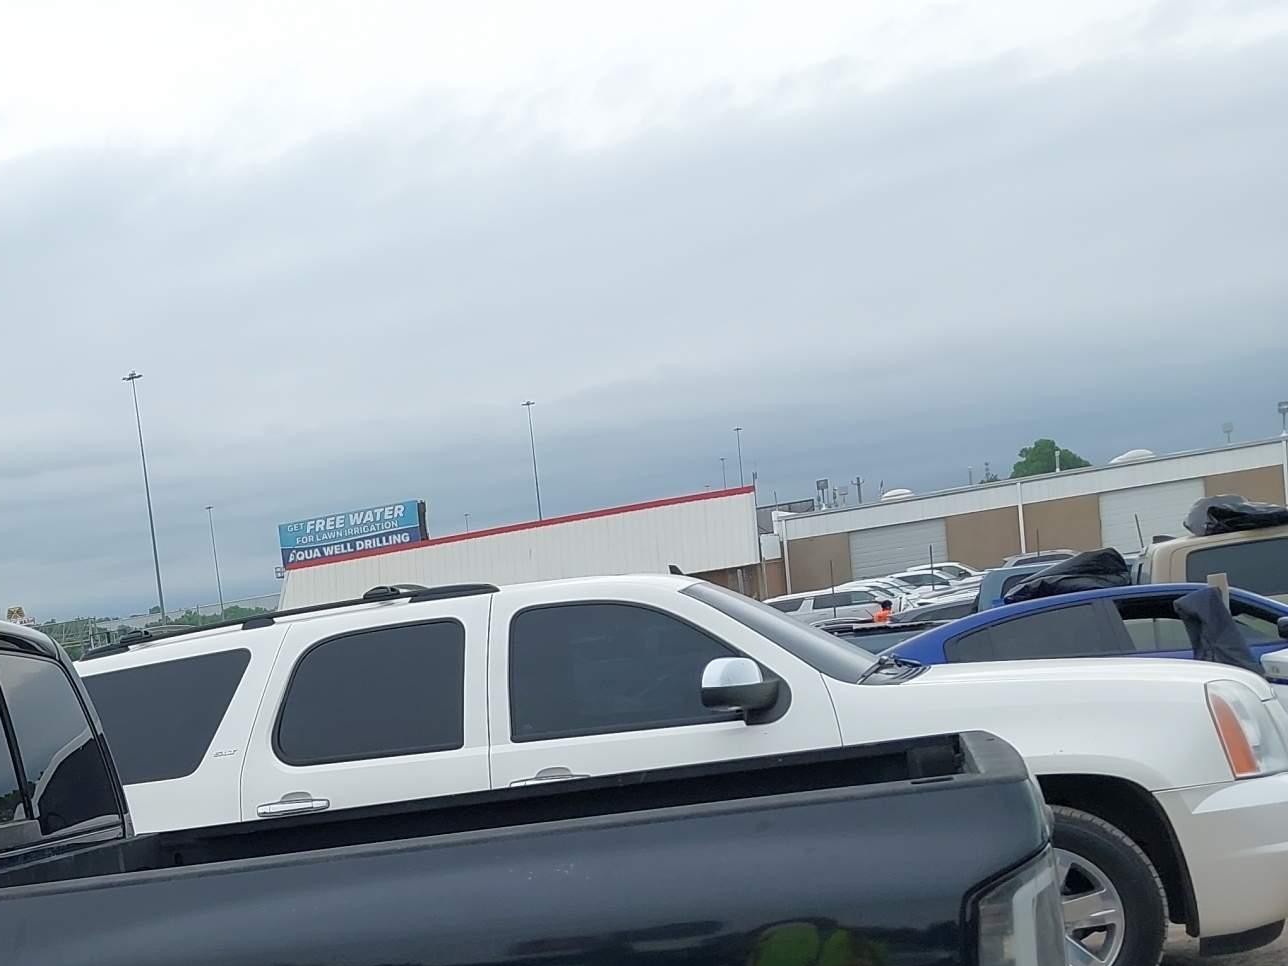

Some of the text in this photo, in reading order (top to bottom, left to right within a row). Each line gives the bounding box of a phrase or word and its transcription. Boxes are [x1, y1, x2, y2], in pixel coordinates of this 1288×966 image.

[287, 504, 405, 534] GET FREE WATER
[296, 520, 399, 545] FOR LAWN IRRIGATION
[288, 532, 410, 563] AQUA WELL DRILLING
